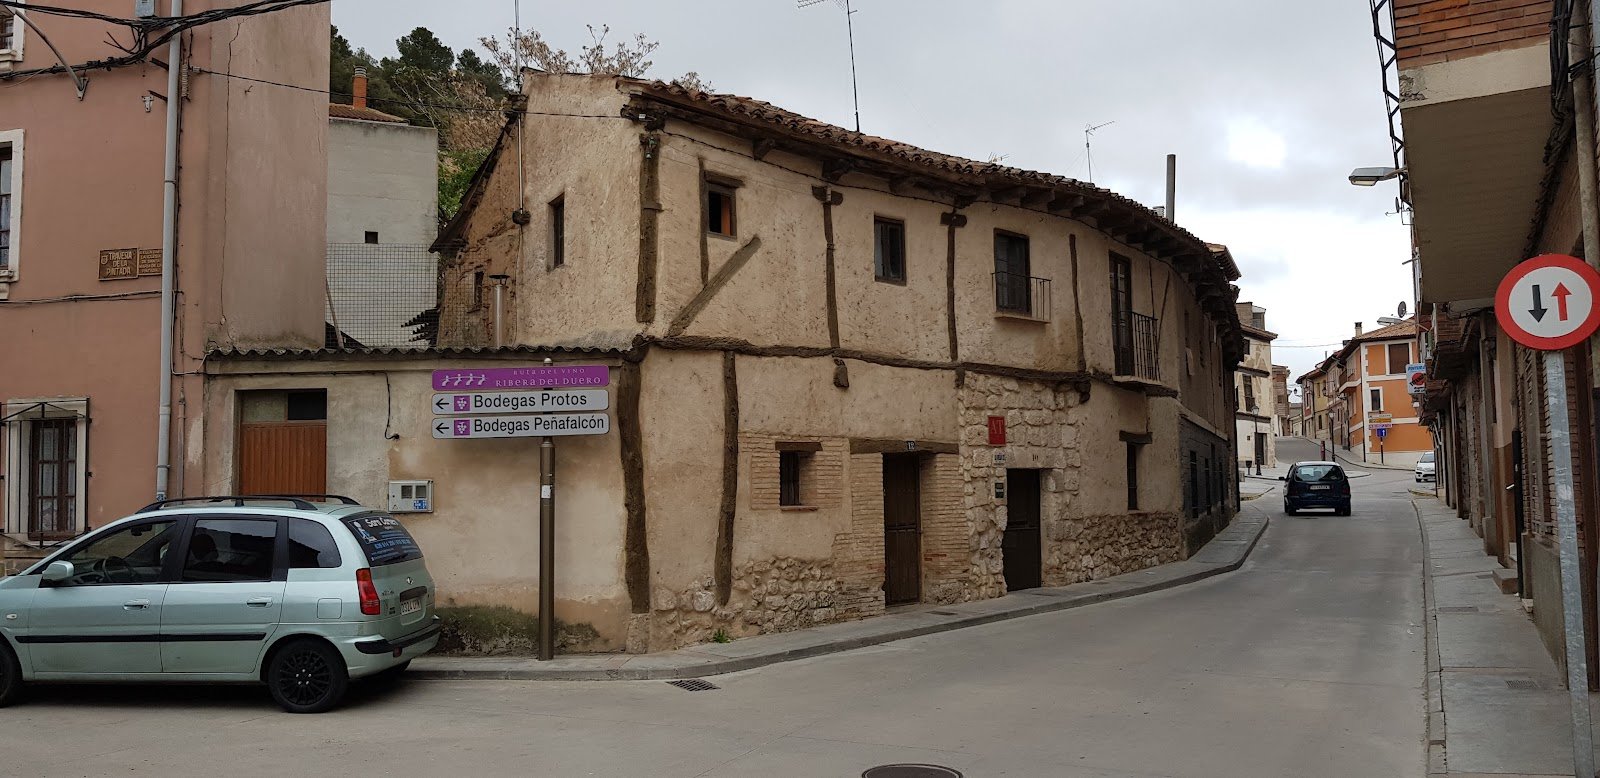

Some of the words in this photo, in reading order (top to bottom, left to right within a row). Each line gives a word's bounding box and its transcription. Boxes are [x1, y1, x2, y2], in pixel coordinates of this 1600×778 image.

[113, 260, 120, 268] DE
[106, 266, 131, 276] PINTADA
[474, 394, 536, 410] Bodegas
[541, 393, 587, 406] Protos
[474, 418, 530, 435] Bodegas
[534, 415, 604, 431] Peñafalcón
